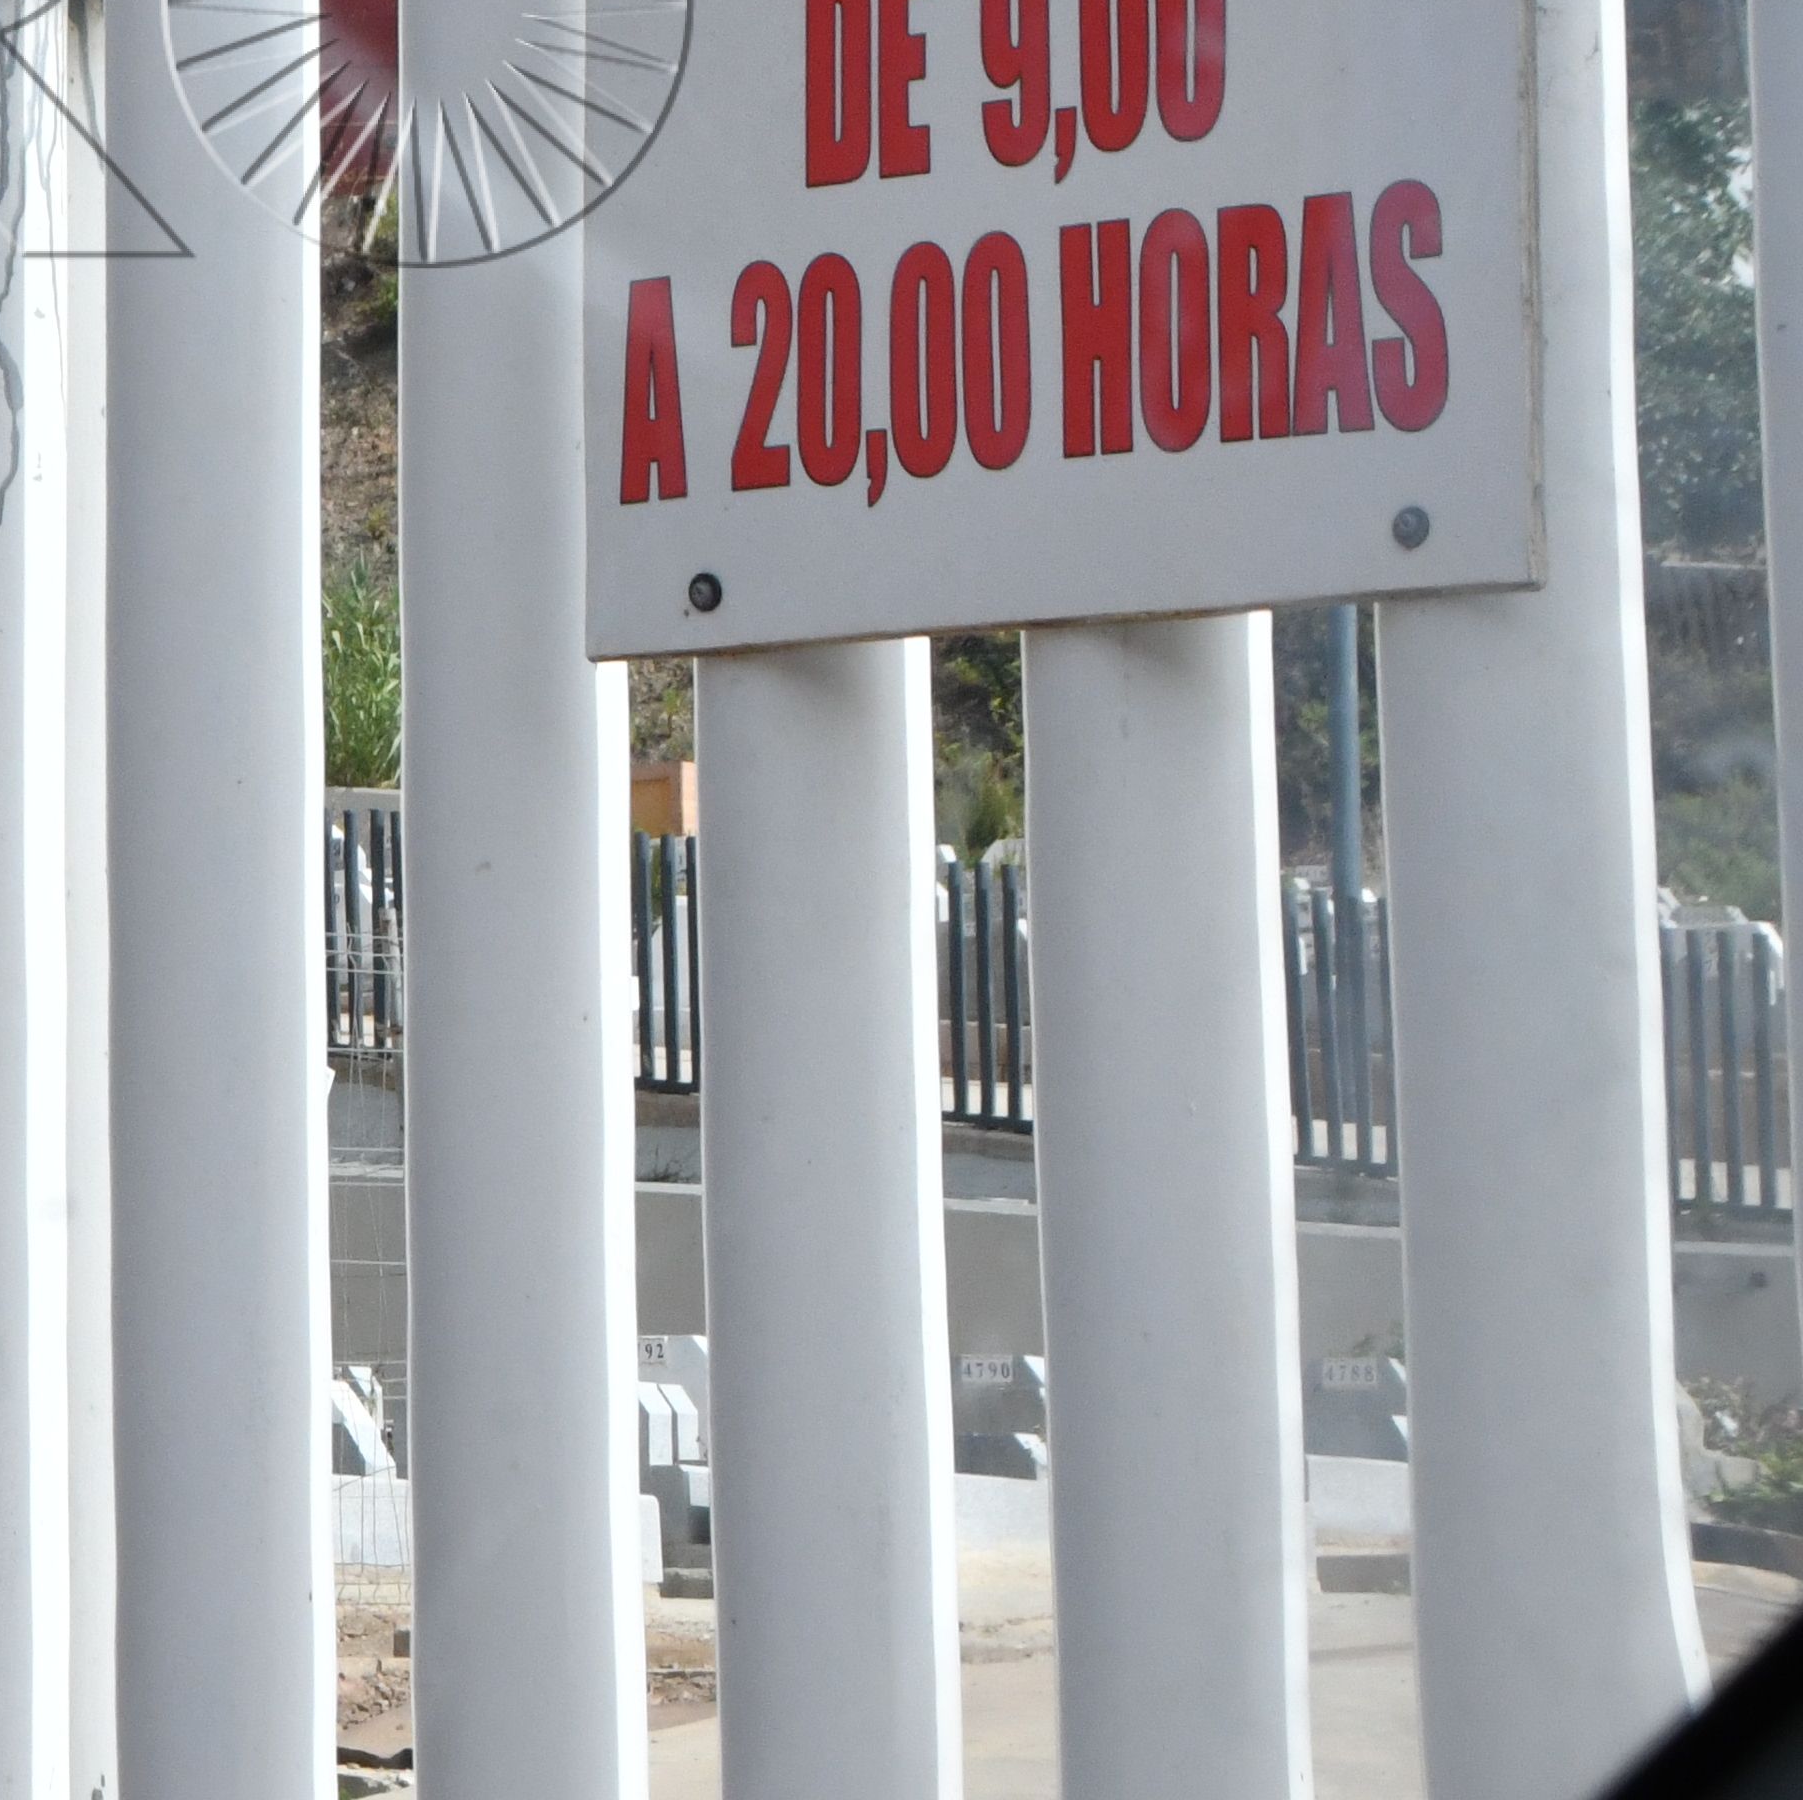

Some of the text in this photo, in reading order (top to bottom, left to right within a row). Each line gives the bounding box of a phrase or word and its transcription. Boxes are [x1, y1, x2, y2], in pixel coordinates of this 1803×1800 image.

[619, 178, 1449, 507] A 20,00 HORAS
[644, 1342, 664, 1359] 92
[962, 1361, 1011, 1379] 4790
